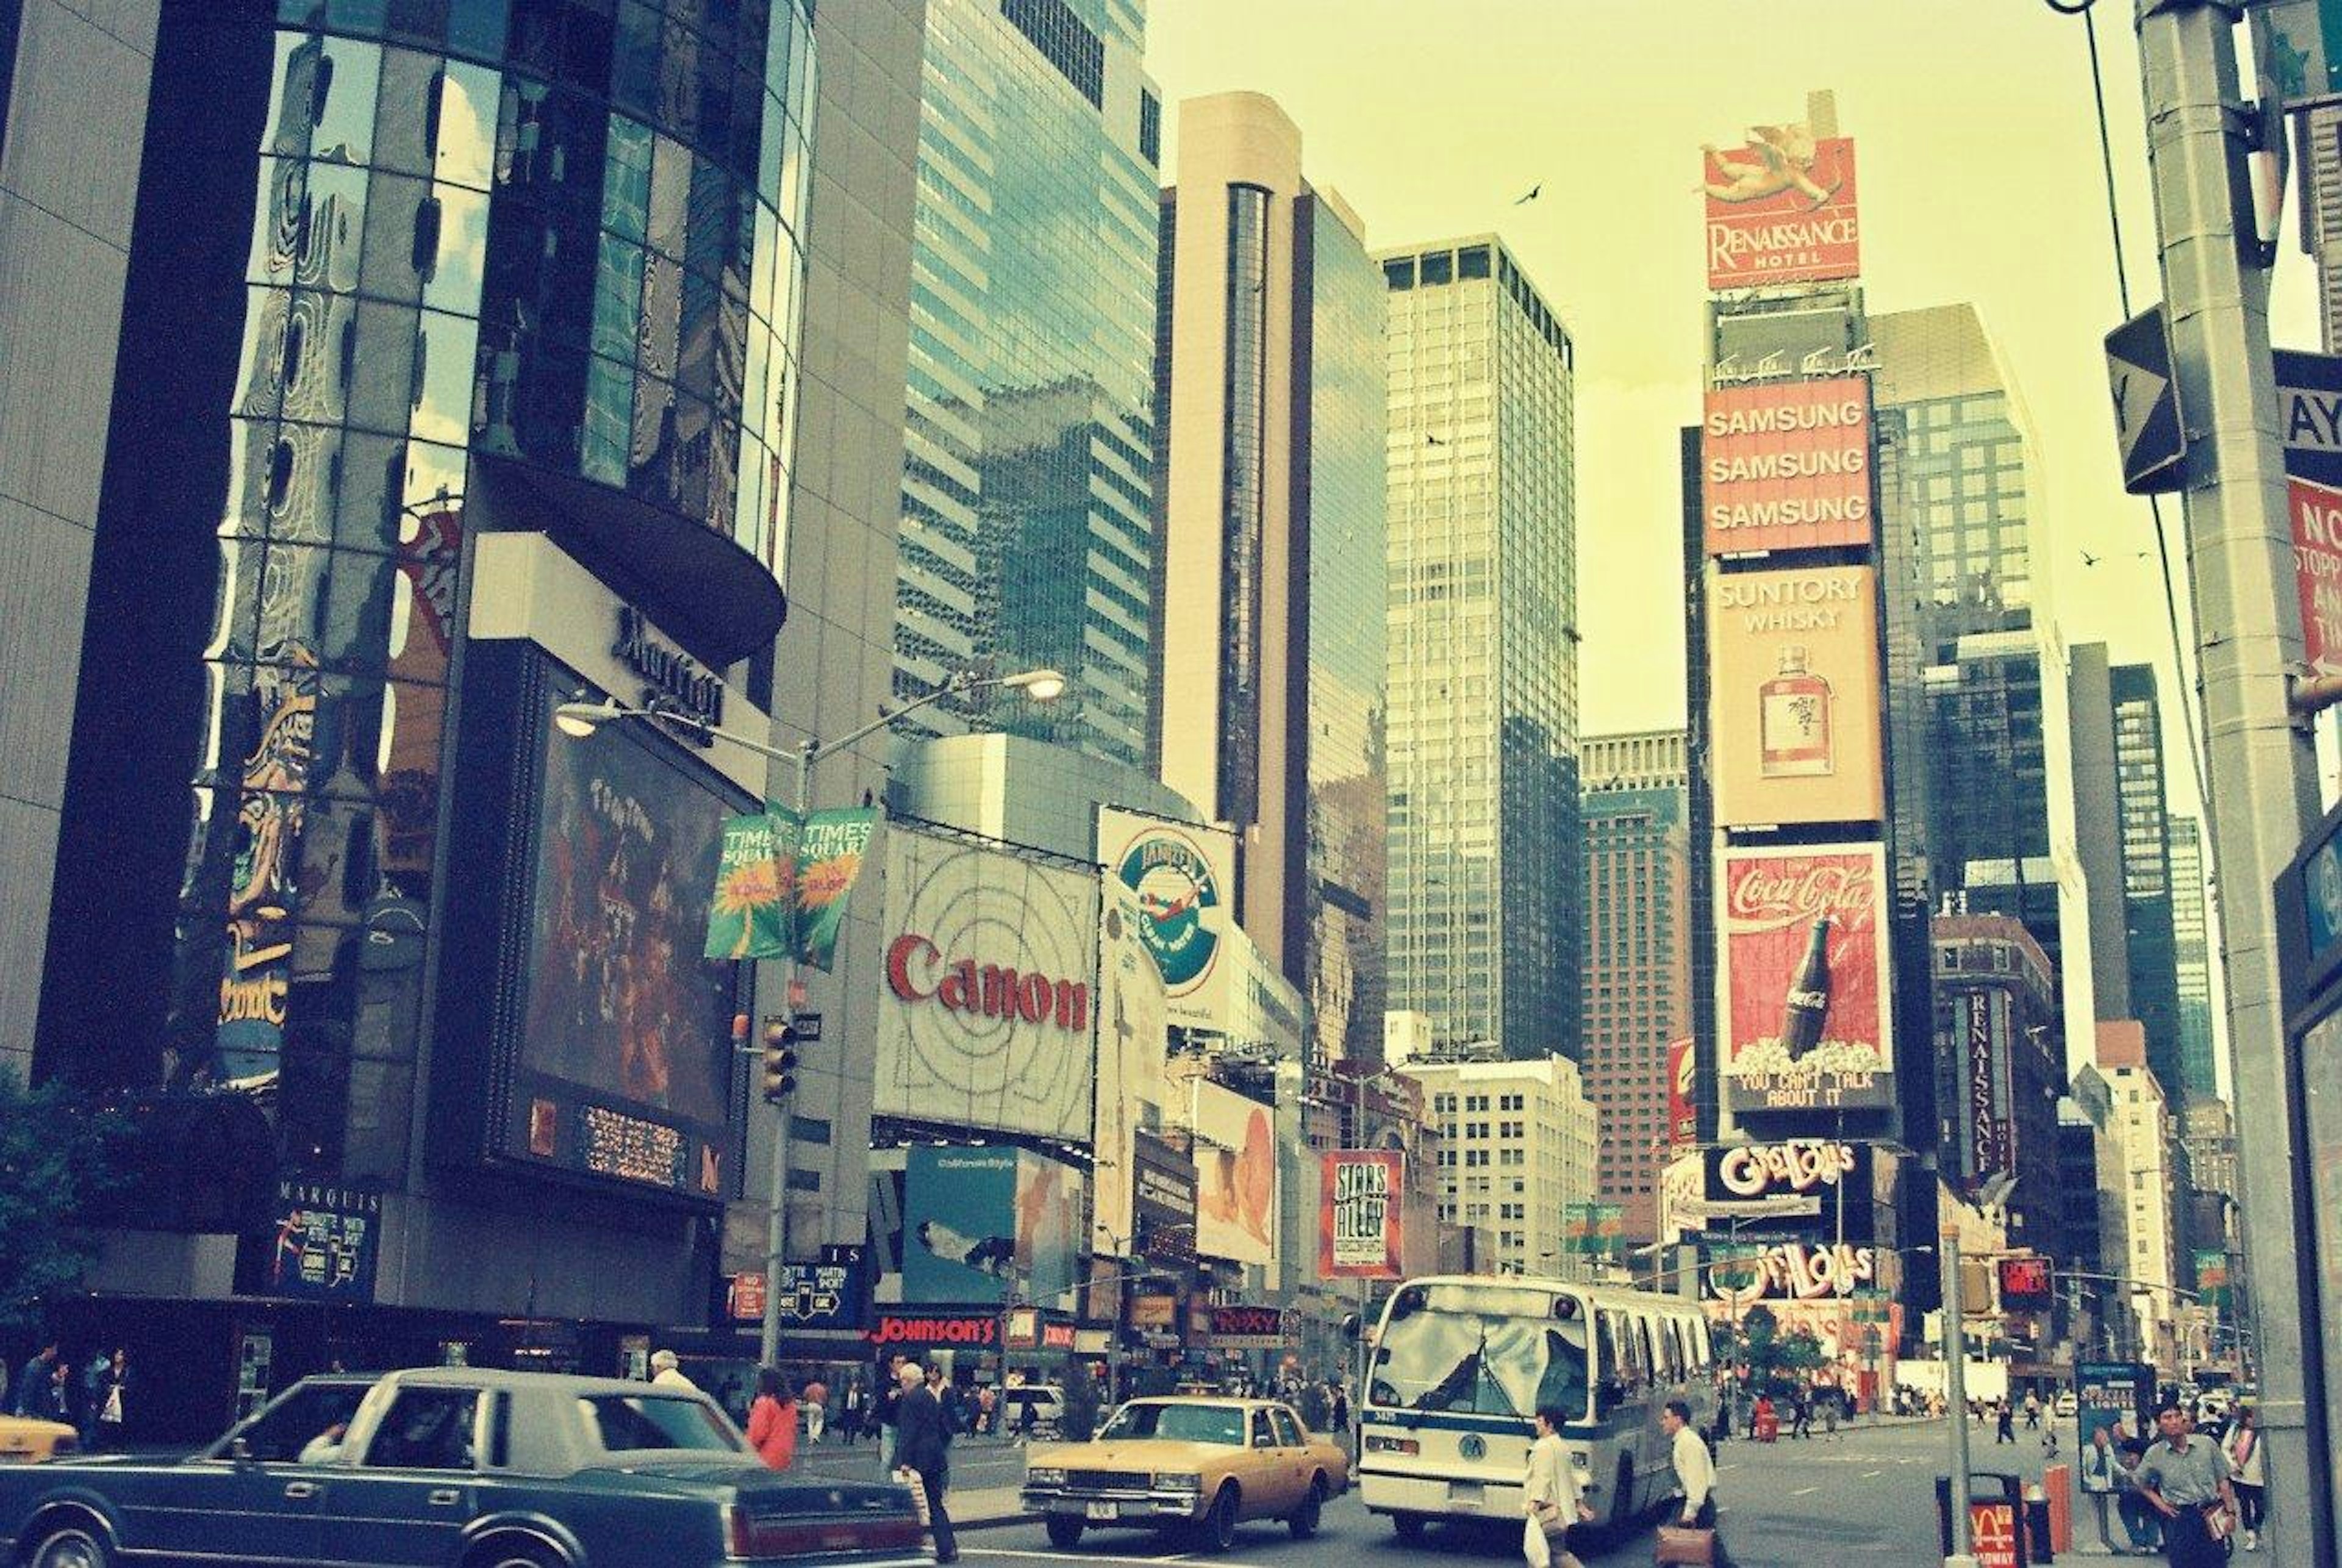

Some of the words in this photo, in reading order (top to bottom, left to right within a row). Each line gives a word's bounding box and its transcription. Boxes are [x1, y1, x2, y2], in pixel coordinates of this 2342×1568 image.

[1708, 217, 1858, 271] RENAISSANCE
[1755, 251, 1822, 268] HOTEL
[1708, 401, 1863, 437] SAMSUNG
[1709, 448, 1865, 484] SAMSUNG
[1710, 495, 1868, 531] SAMSUNG
[1719, 575, 1863, 608] SUNTORY
[1745, 608, 1837, 634] WHISKY
[888, 934, 1087, 1034] Canon
[1739, 1074, 1770, 1090] YOU
[1778, 1073, 1820, 1089] CAN'T
[1834, 1072, 1874, 1087] TALK
[1767, 1089, 1816, 1106] ABOUT
[1827, 1088, 1843, 1104] IT
[1971, 993, 1992, 1172] RENAISSANCE
[280, 1181, 379, 1214] MARQUIS
[1338, 1165, 1386, 1200] STARS
[1338, 1195, 1384, 1237] ALLEY
